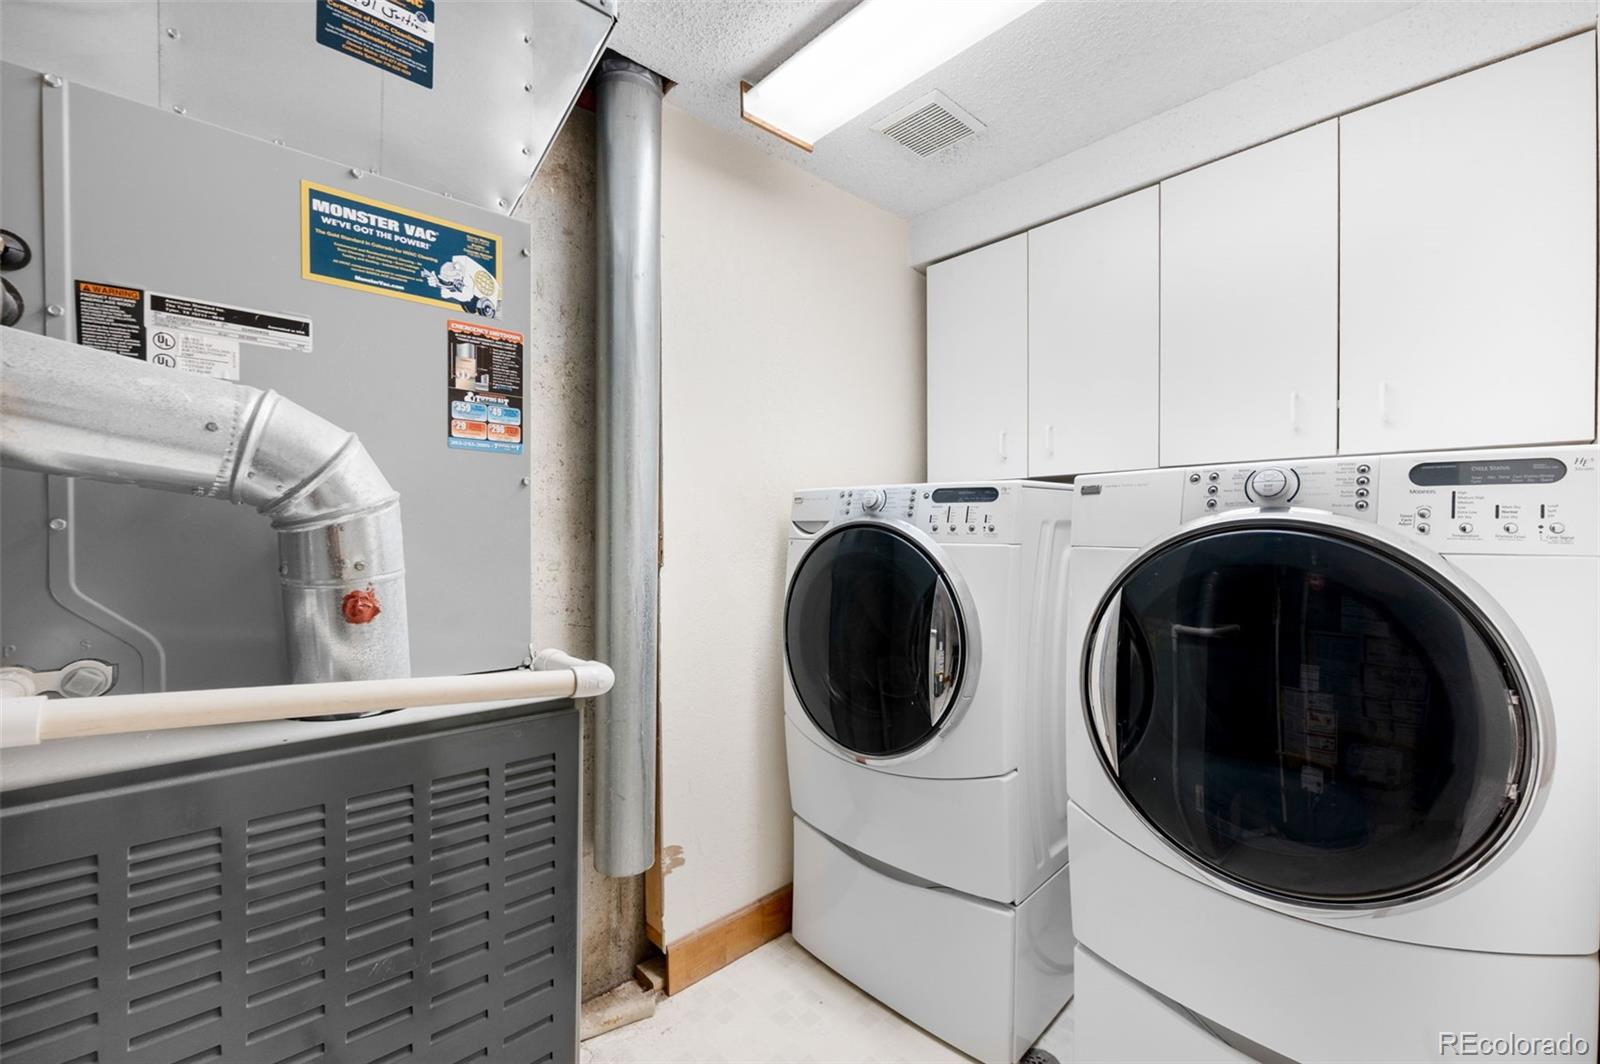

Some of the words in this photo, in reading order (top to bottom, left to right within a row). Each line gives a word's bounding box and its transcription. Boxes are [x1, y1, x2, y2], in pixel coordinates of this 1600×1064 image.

[312, 198, 399, 232] MONSTER
[404, 223, 438, 242] VAC
[315, 228, 326, 236] The
[320, 215, 351, 230] WE'VE
[353, 223, 374, 236] GOT
[375, 228, 392, 241] THE
[394, 234, 430, 250] POWER!
[354, 274, 405, 290] MonsterVac.com
[92, 285, 139, 298] WARNING
[157, 333, 171, 347] UL
